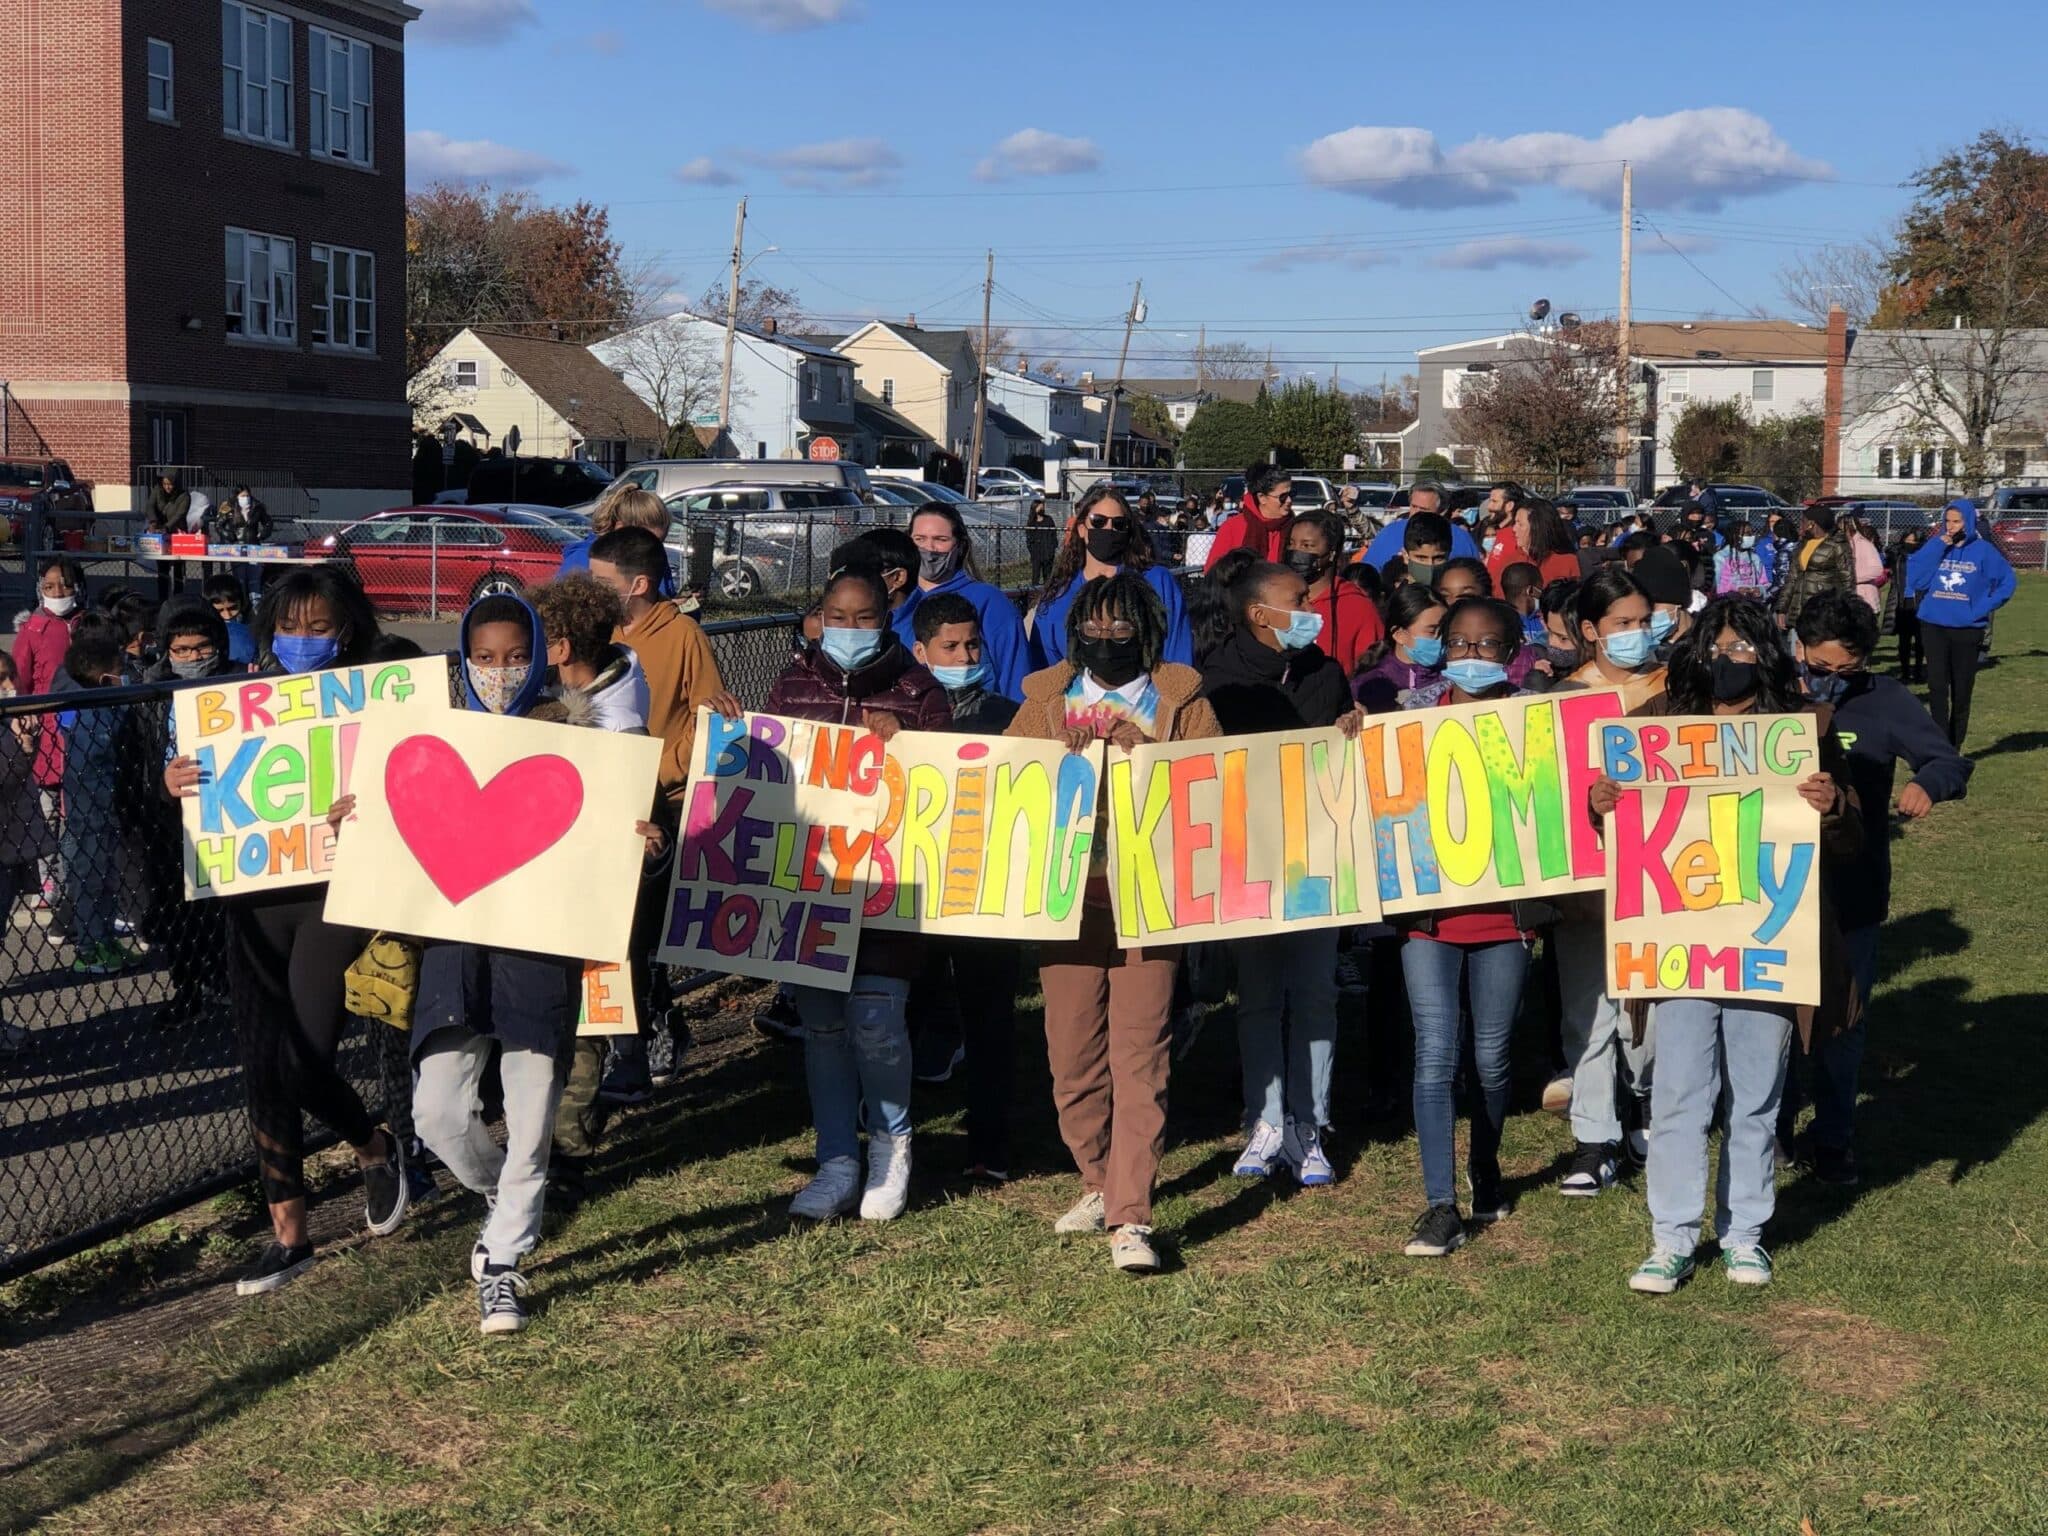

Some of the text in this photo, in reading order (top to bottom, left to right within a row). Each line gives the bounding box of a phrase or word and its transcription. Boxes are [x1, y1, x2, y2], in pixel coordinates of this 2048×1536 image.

[812, 446, 837, 458] STOP
[195, 664, 416, 738] BRING
[194, 721, 362, 834] Kell
[704, 712, 886, 797] BRING
[1602, 716, 1813, 783] BRING
[679, 780, 876, 896] KELLY
[1110, 738, 1363, 939] KELLY
[1361, 691, 1624, 901] HOME
[196, 822, 338, 889] HOME
[1614, 785, 1816, 945] Kelly
[665, 887, 851, 974] HOME
[1614, 942, 1788, 993] HOME
